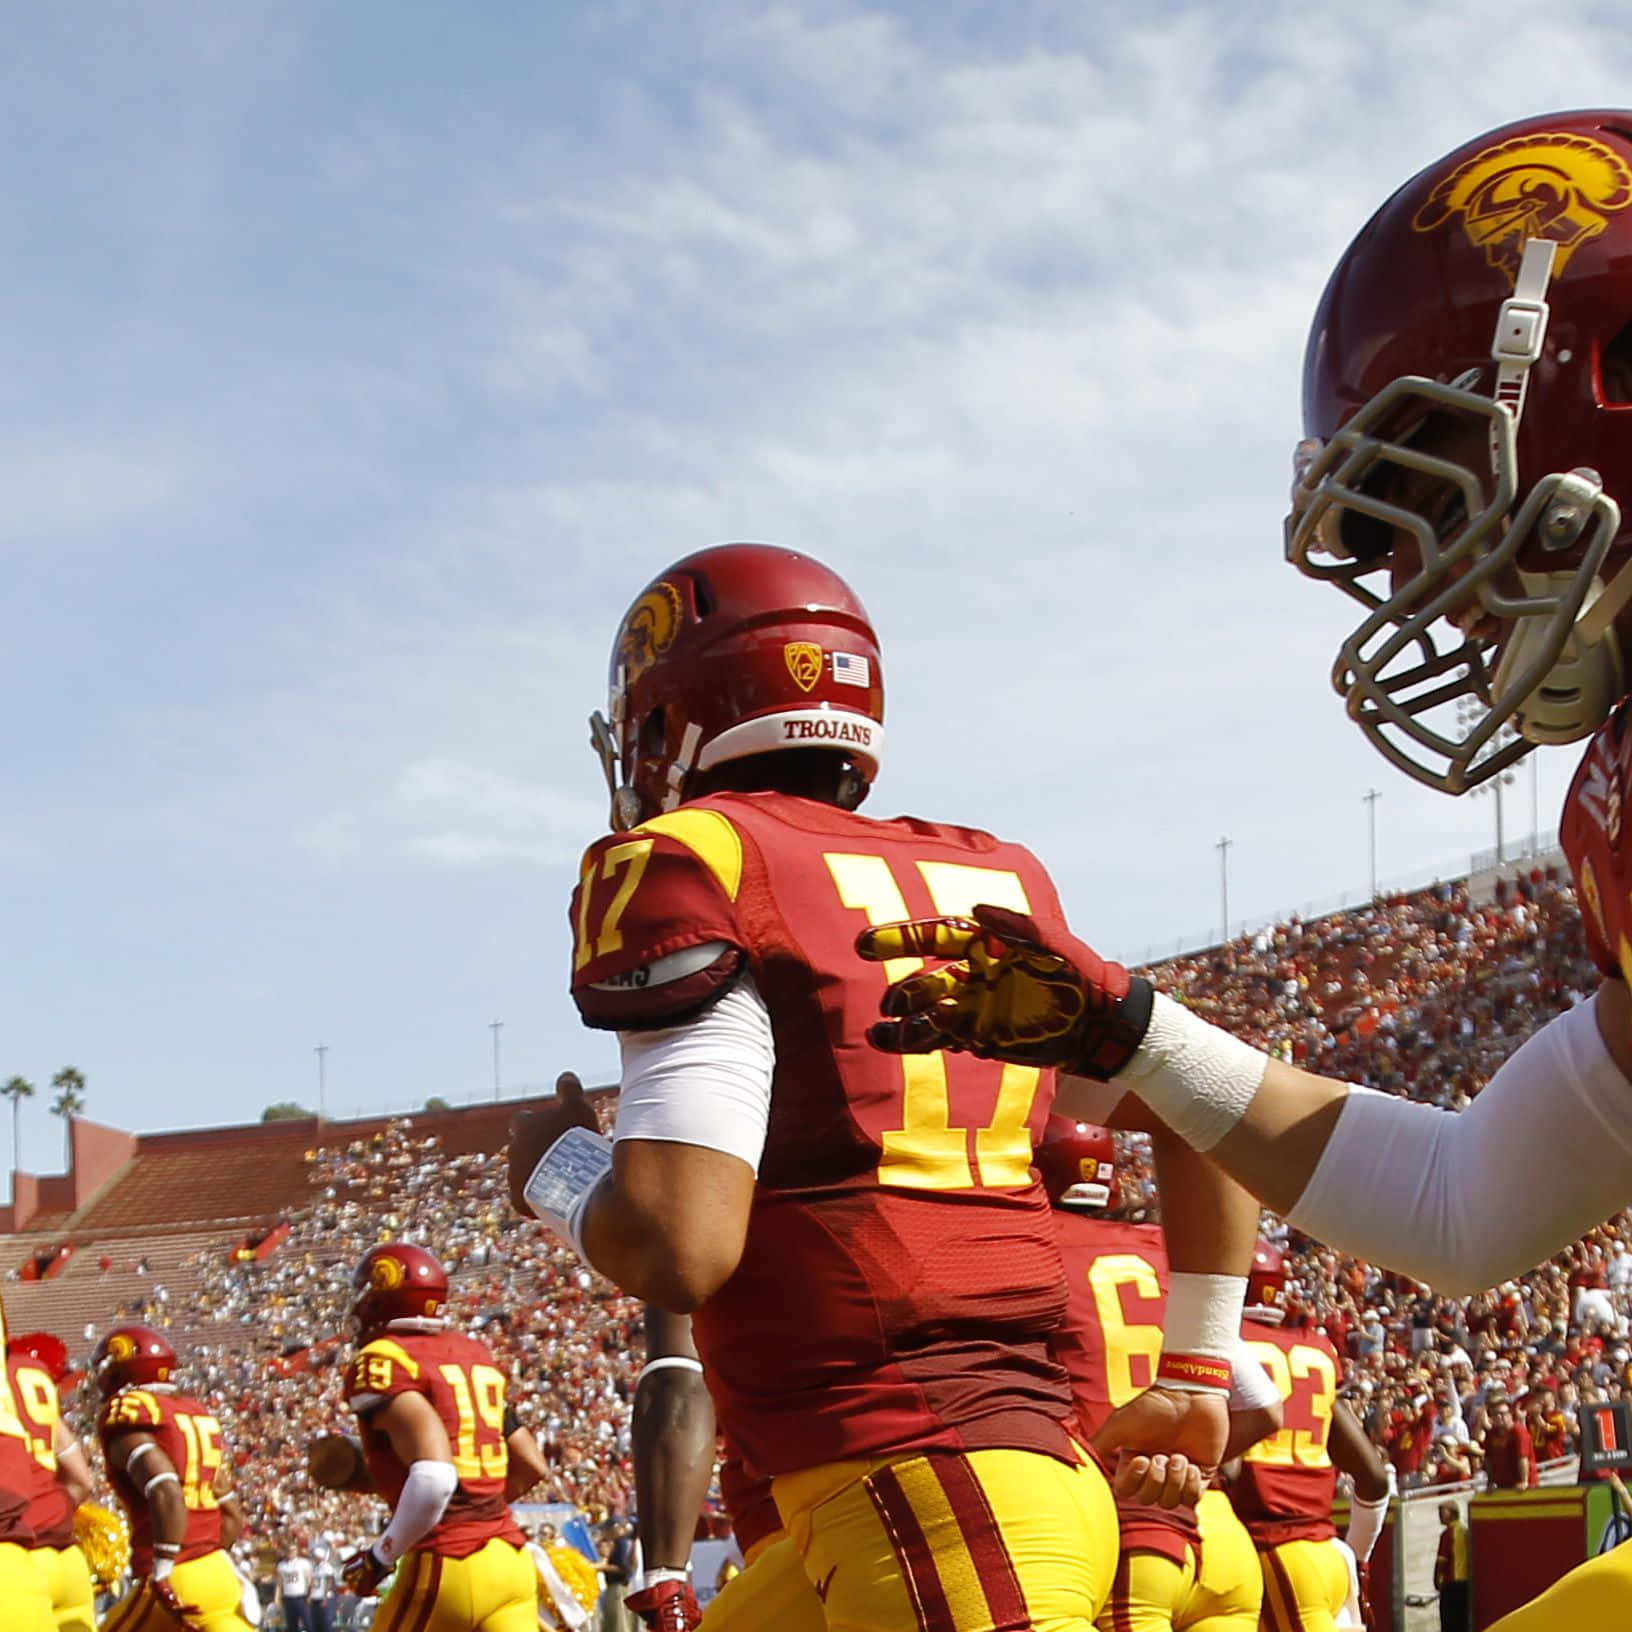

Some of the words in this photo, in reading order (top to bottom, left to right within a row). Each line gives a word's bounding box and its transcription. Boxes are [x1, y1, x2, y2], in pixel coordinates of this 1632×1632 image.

[784, 719, 872, 746] TROJANS
[575, 838, 656, 972] 17
[822, 852, 1039, 1190] 17
[1087, 1254, 1165, 1409] 6
[15, 1366, 60, 1473] 9
[173, 1412, 223, 1510] 15
[438, 1363, 509, 1479] 19
[1595, 1408, 1617, 1452] 1
